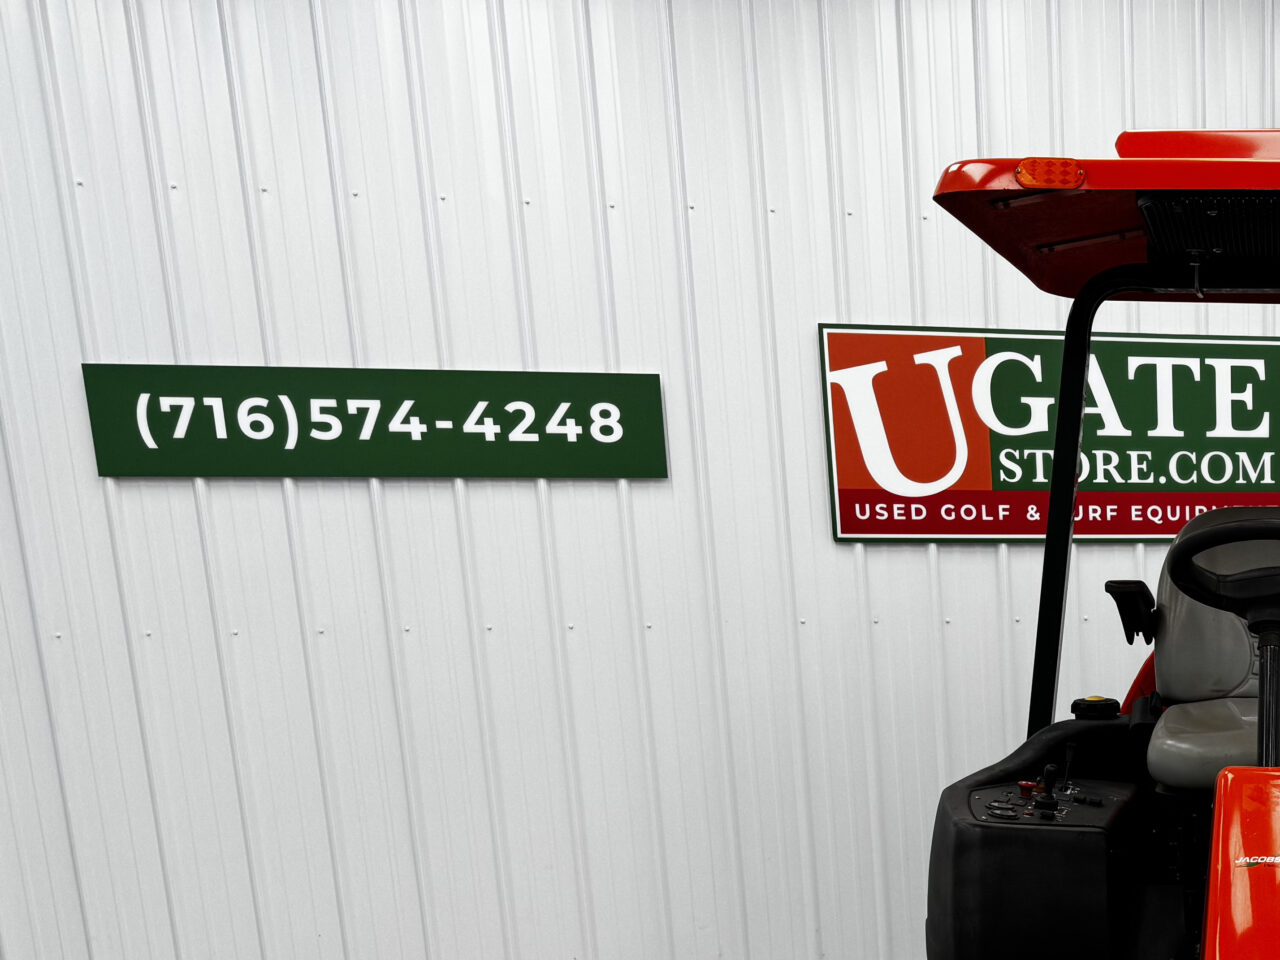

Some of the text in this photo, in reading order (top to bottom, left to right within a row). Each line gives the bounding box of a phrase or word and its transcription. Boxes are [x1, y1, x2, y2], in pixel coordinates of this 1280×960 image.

[136, 393, 624, 449] (716)574-4248
[855, 503, 927, 520] USED
[940, 504, 1010, 521] GOLF
[1026, 505, 1041, 521] &
[1073, 505, 1118, 521] URF
